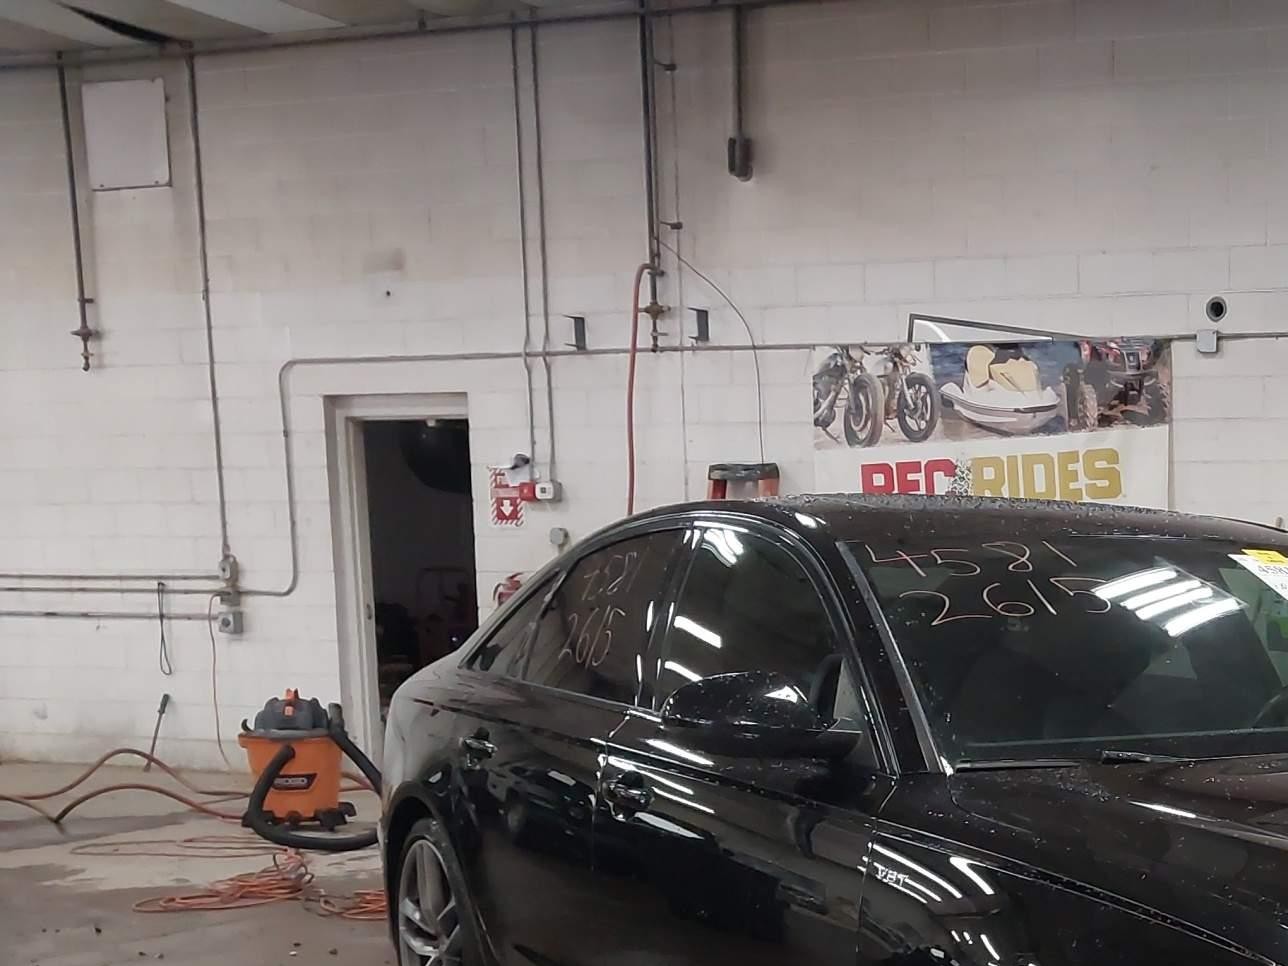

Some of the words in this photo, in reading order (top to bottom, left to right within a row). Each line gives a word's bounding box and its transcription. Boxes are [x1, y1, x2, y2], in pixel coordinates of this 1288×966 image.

[967, 448, 1123, 501] RIDES
[864, 539, 1079, 578] 4581
[898, 578, 1113, 627] 2615
